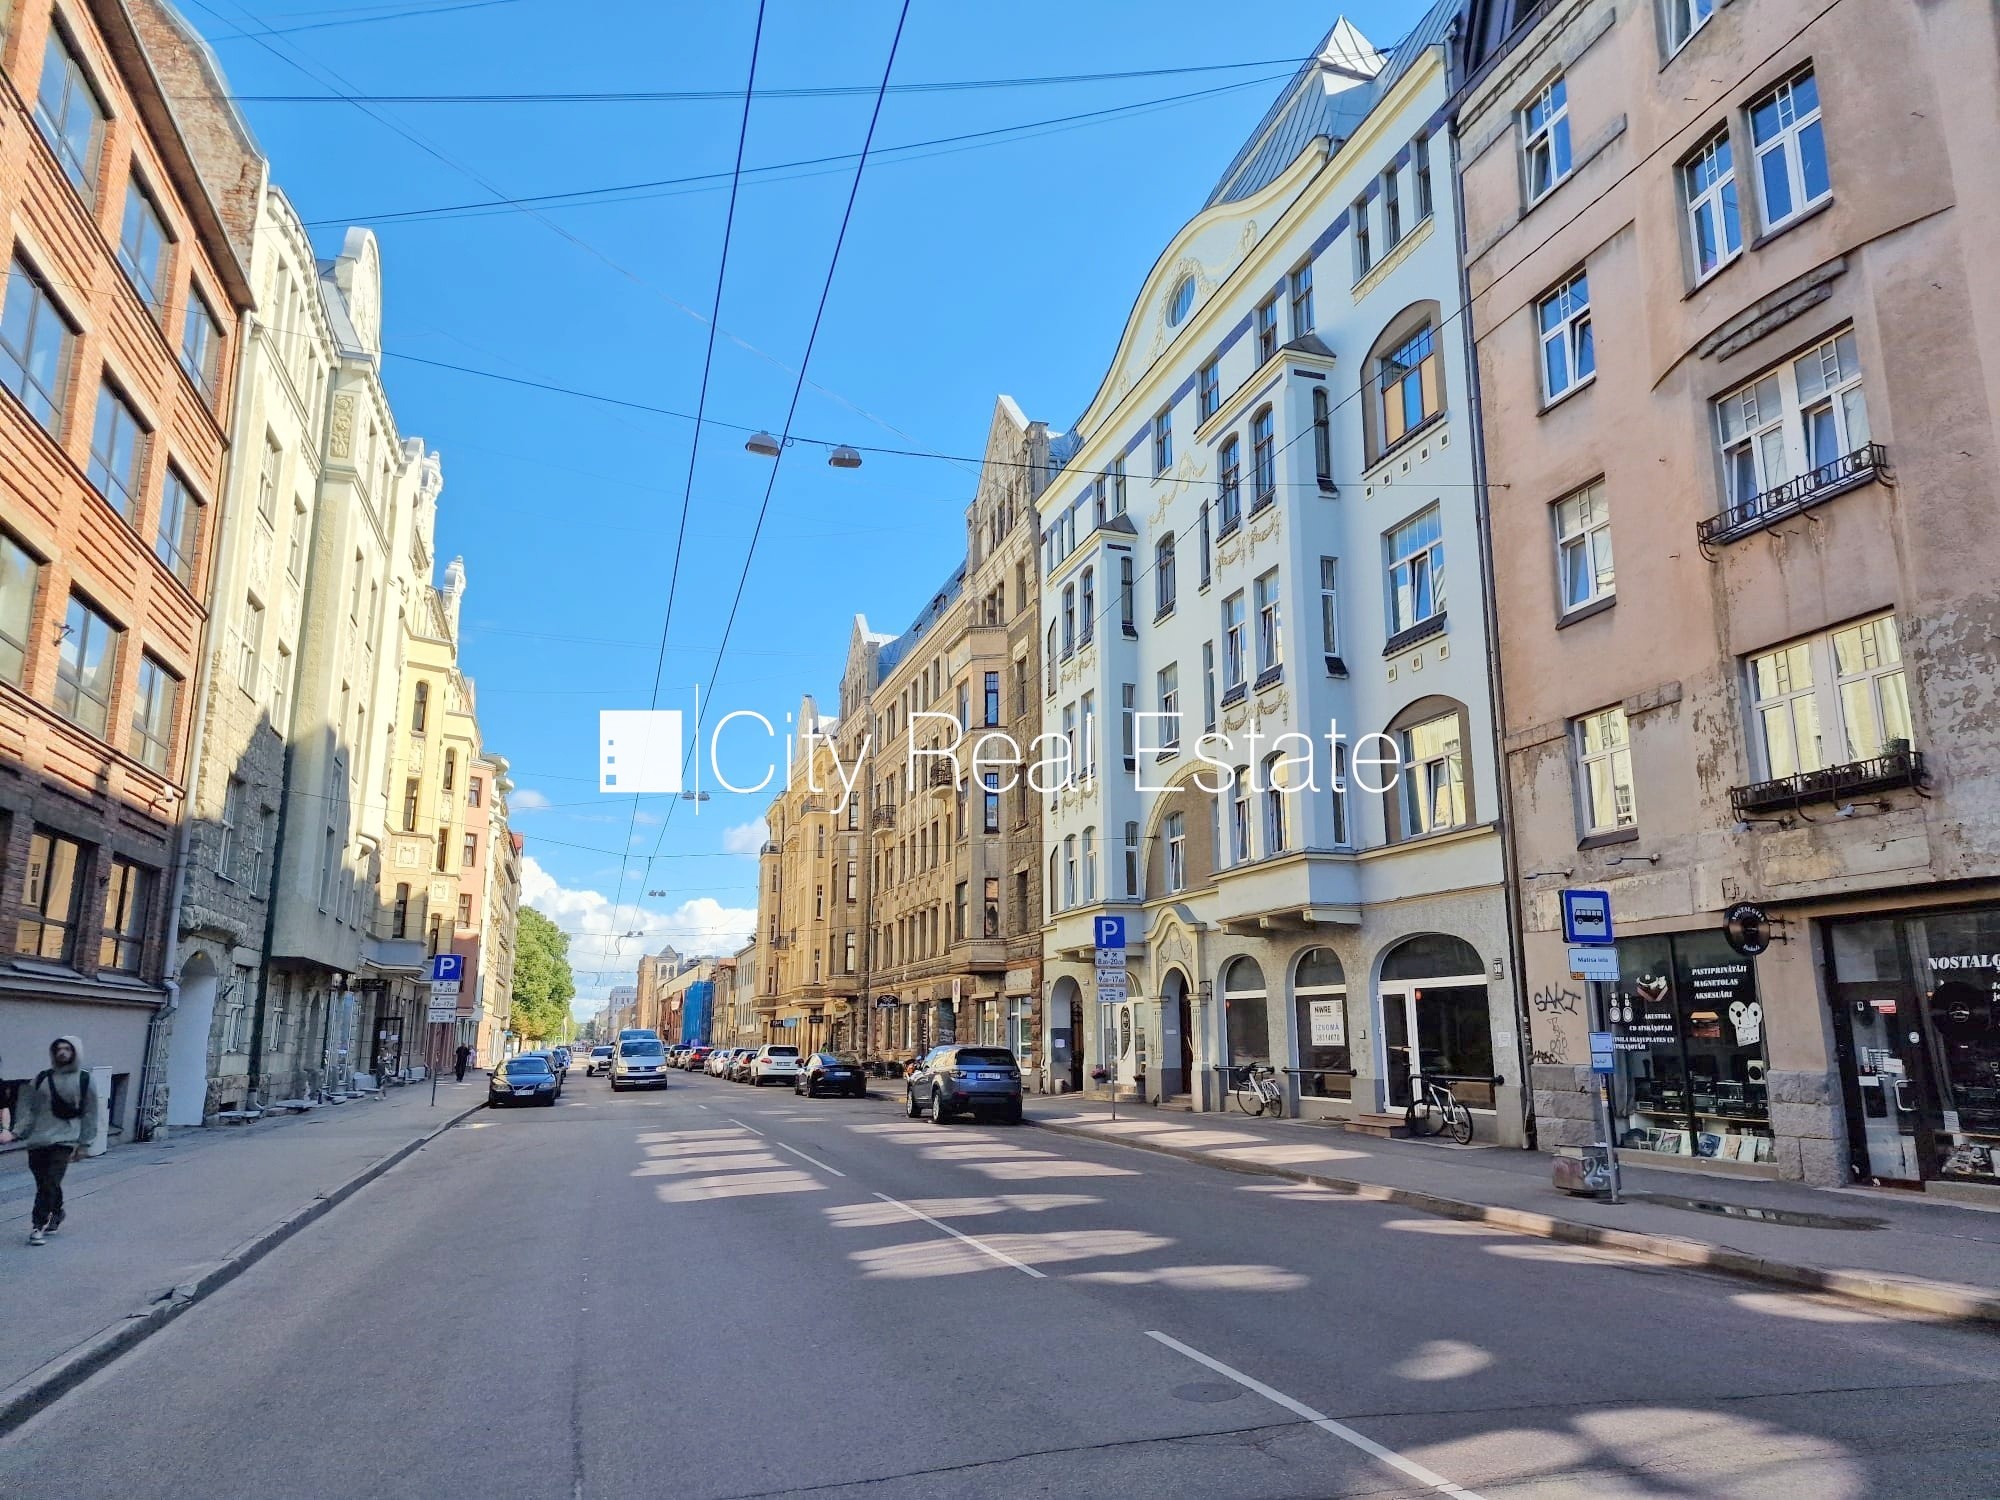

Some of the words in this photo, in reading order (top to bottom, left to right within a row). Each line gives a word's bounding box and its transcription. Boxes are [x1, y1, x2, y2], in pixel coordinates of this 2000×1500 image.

[1101, 920, 1118, 945] P
[439, 957, 456, 977] P
[1694, 978, 1739, 988] MAGNETOLAS
